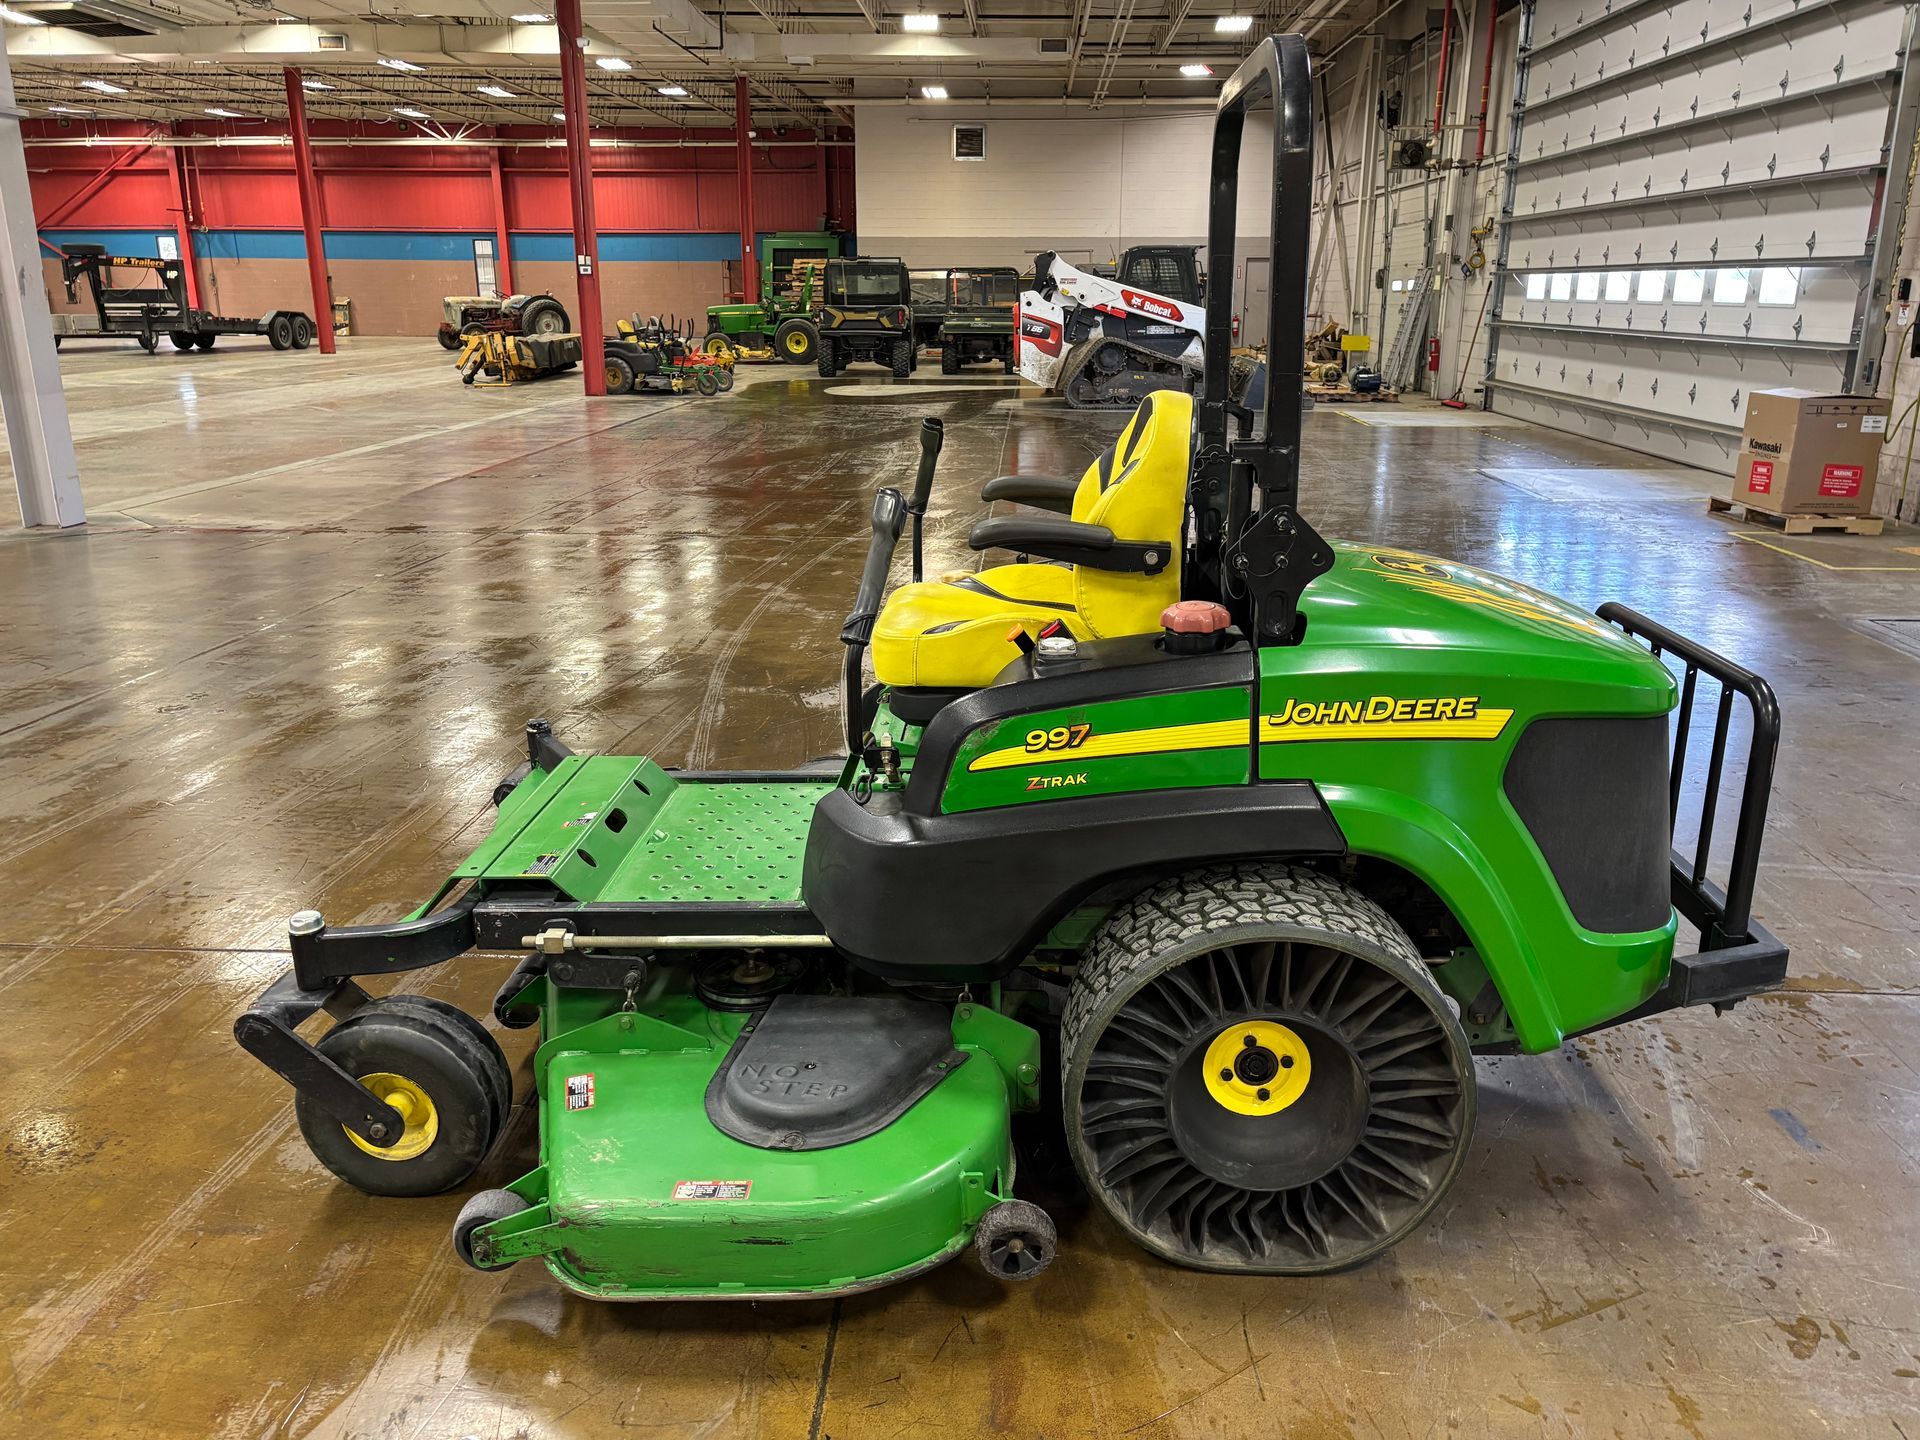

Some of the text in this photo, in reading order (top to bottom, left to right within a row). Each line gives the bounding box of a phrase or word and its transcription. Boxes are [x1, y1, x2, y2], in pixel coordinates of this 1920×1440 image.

[113, 256, 165, 267] HP Trailers
[166, 270, 178, 279] HP
[1143, 300, 1172, 318] Bobcat
[1749, 438, 1782, 454] Kawasaki
[1269, 696, 1481, 726] JOHN DEERE
[1025, 724, 1092, 753] 997
[1025, 772, 1088, 791] ZTRAK
[738, 1063, 799, 1079] NO
[756, 1079, 848, 1098] STEP
